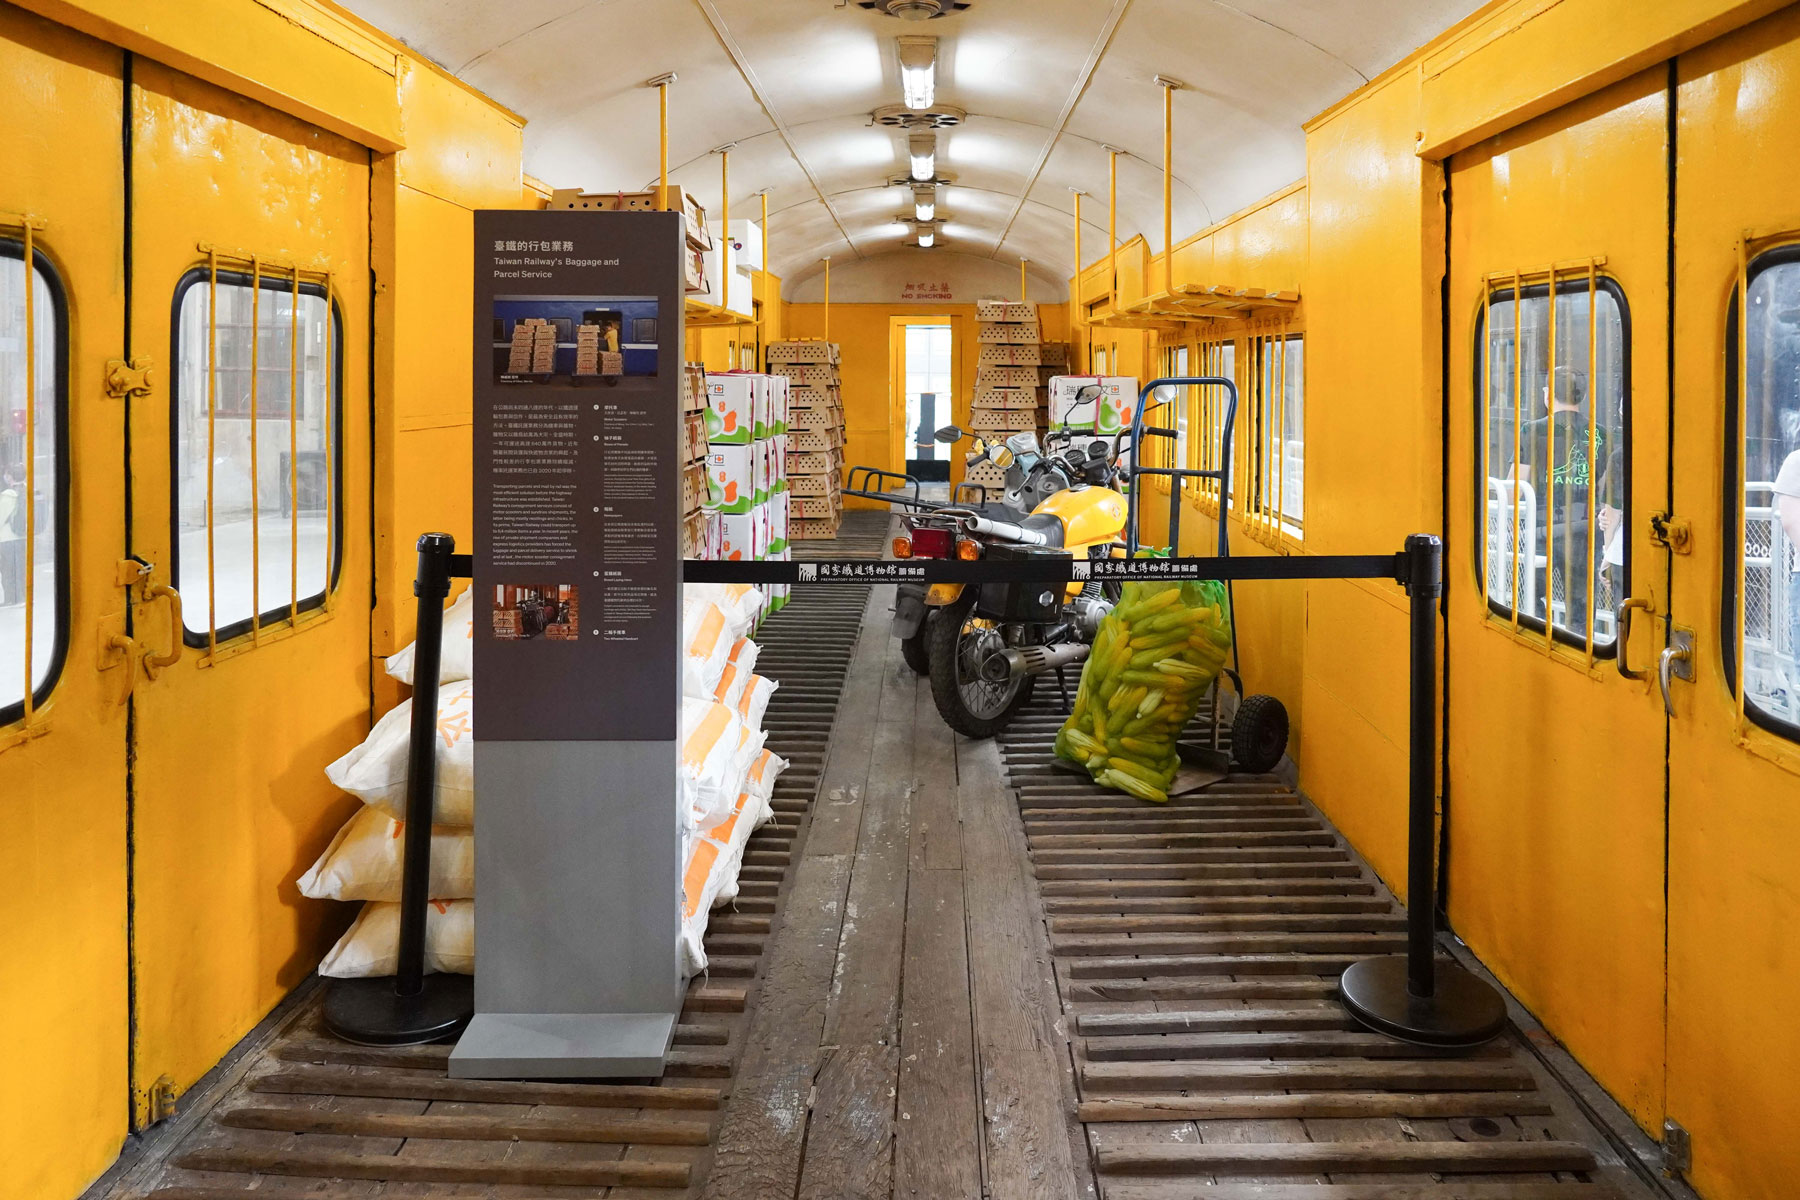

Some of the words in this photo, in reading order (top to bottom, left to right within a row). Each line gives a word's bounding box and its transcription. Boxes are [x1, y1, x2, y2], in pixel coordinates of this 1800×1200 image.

[494, 240, 574, 252] 臺鐵的行包業務
[494, 258, 522, 266] Taiwan
[524, 258, 563, 267] Railway's
[565, 258, 602, 267] Baggage
[604, 258, 619, 266] and
